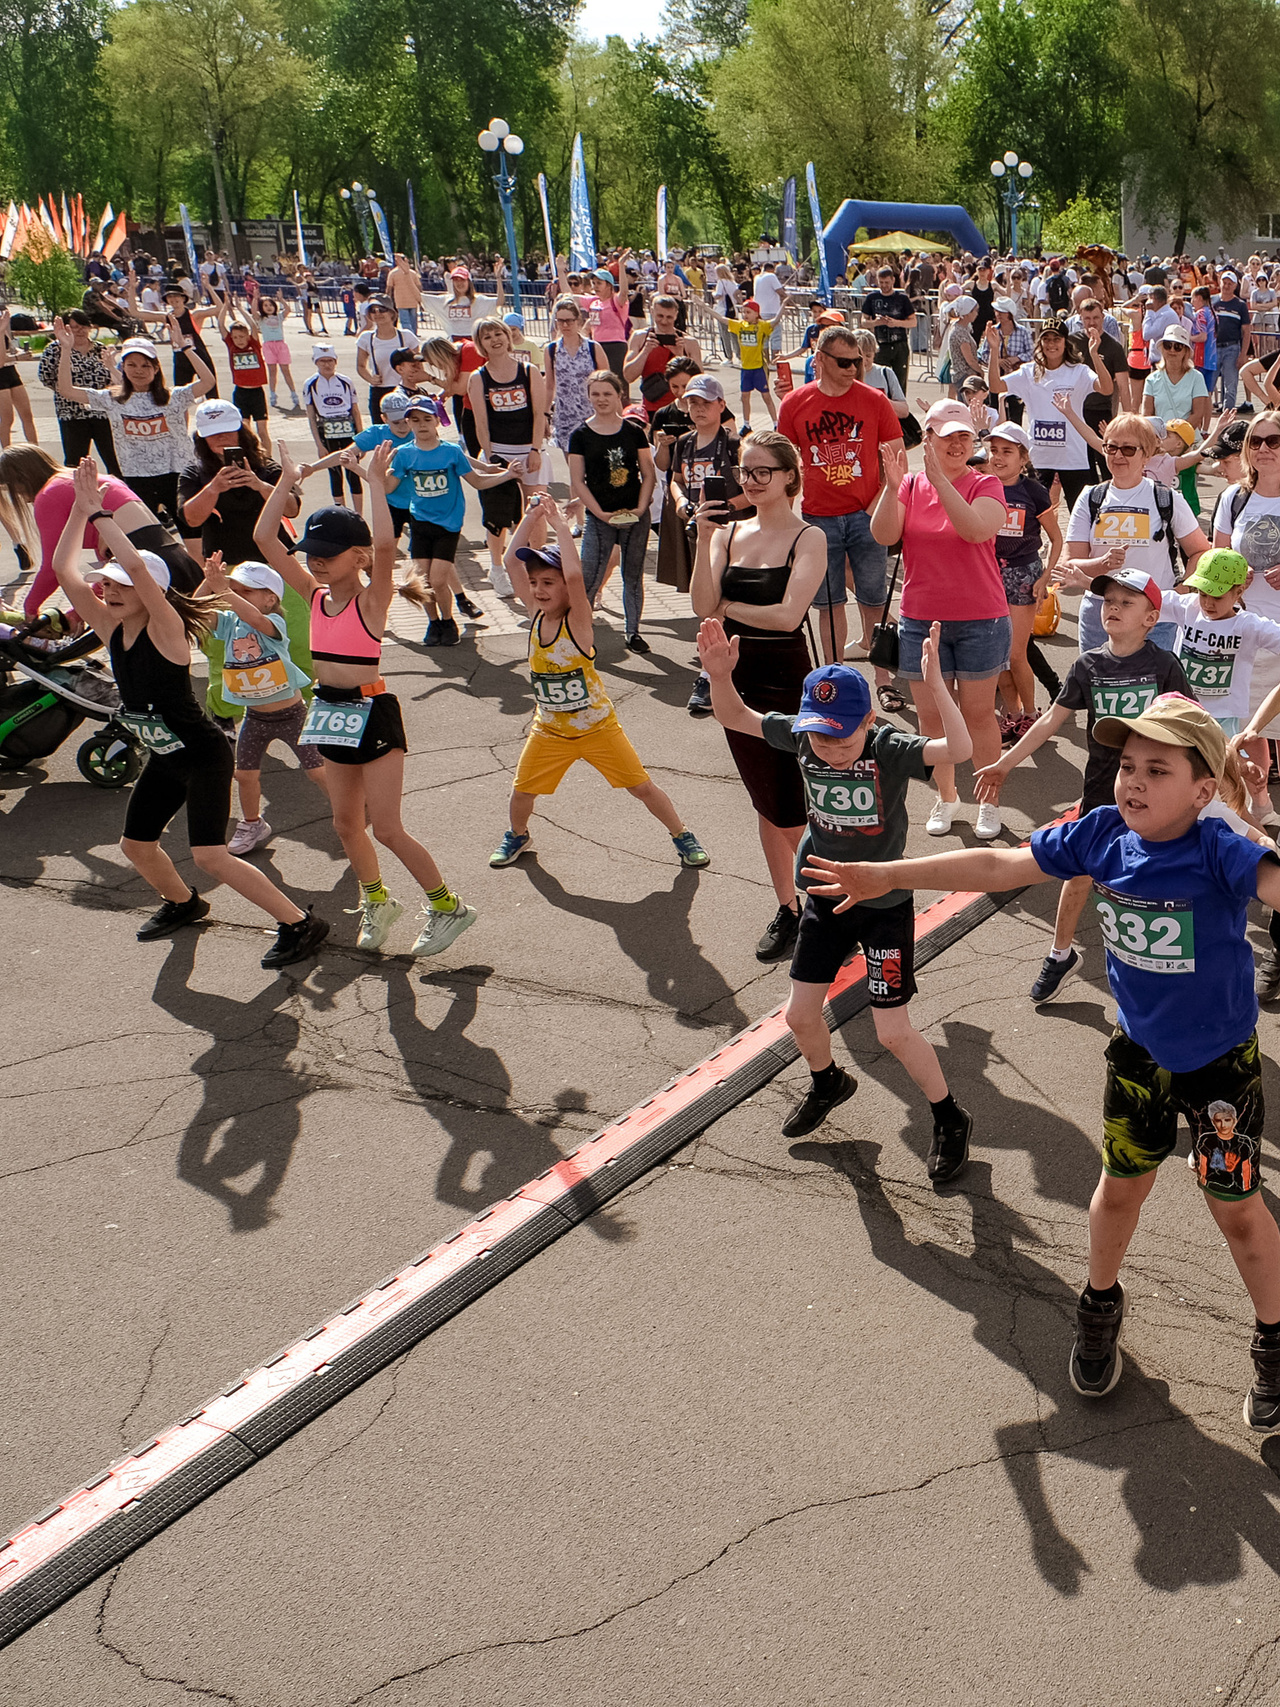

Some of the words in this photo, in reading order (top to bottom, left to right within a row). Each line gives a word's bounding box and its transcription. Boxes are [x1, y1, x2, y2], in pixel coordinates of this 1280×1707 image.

[449, 307, 471, 319] 551
[235, 354, 259, 367] 141
[491, 388, 527, 408] 613
[124, 420, 163, 436] 407
[324, 421, 353, 434] 328
[805, 410, 864, 443] HAPPY
[1034, 427, 1065, 440] 1048
[818, 443, 862, 466] NEW
[413, 474, 448, 491] 140
[820, 464, 856, 482] YEAR
[1103, 514, 1138, 537] 24
[235, 668, 275, 691] 12
[1181, 658, 1232, 685] 1737
[533, 679, 587, 704] 158
[1094, 688, 1157, 716] 1727
[304, 710, 364, 734] 1769
[1096, 901, 1183, 956] 332
